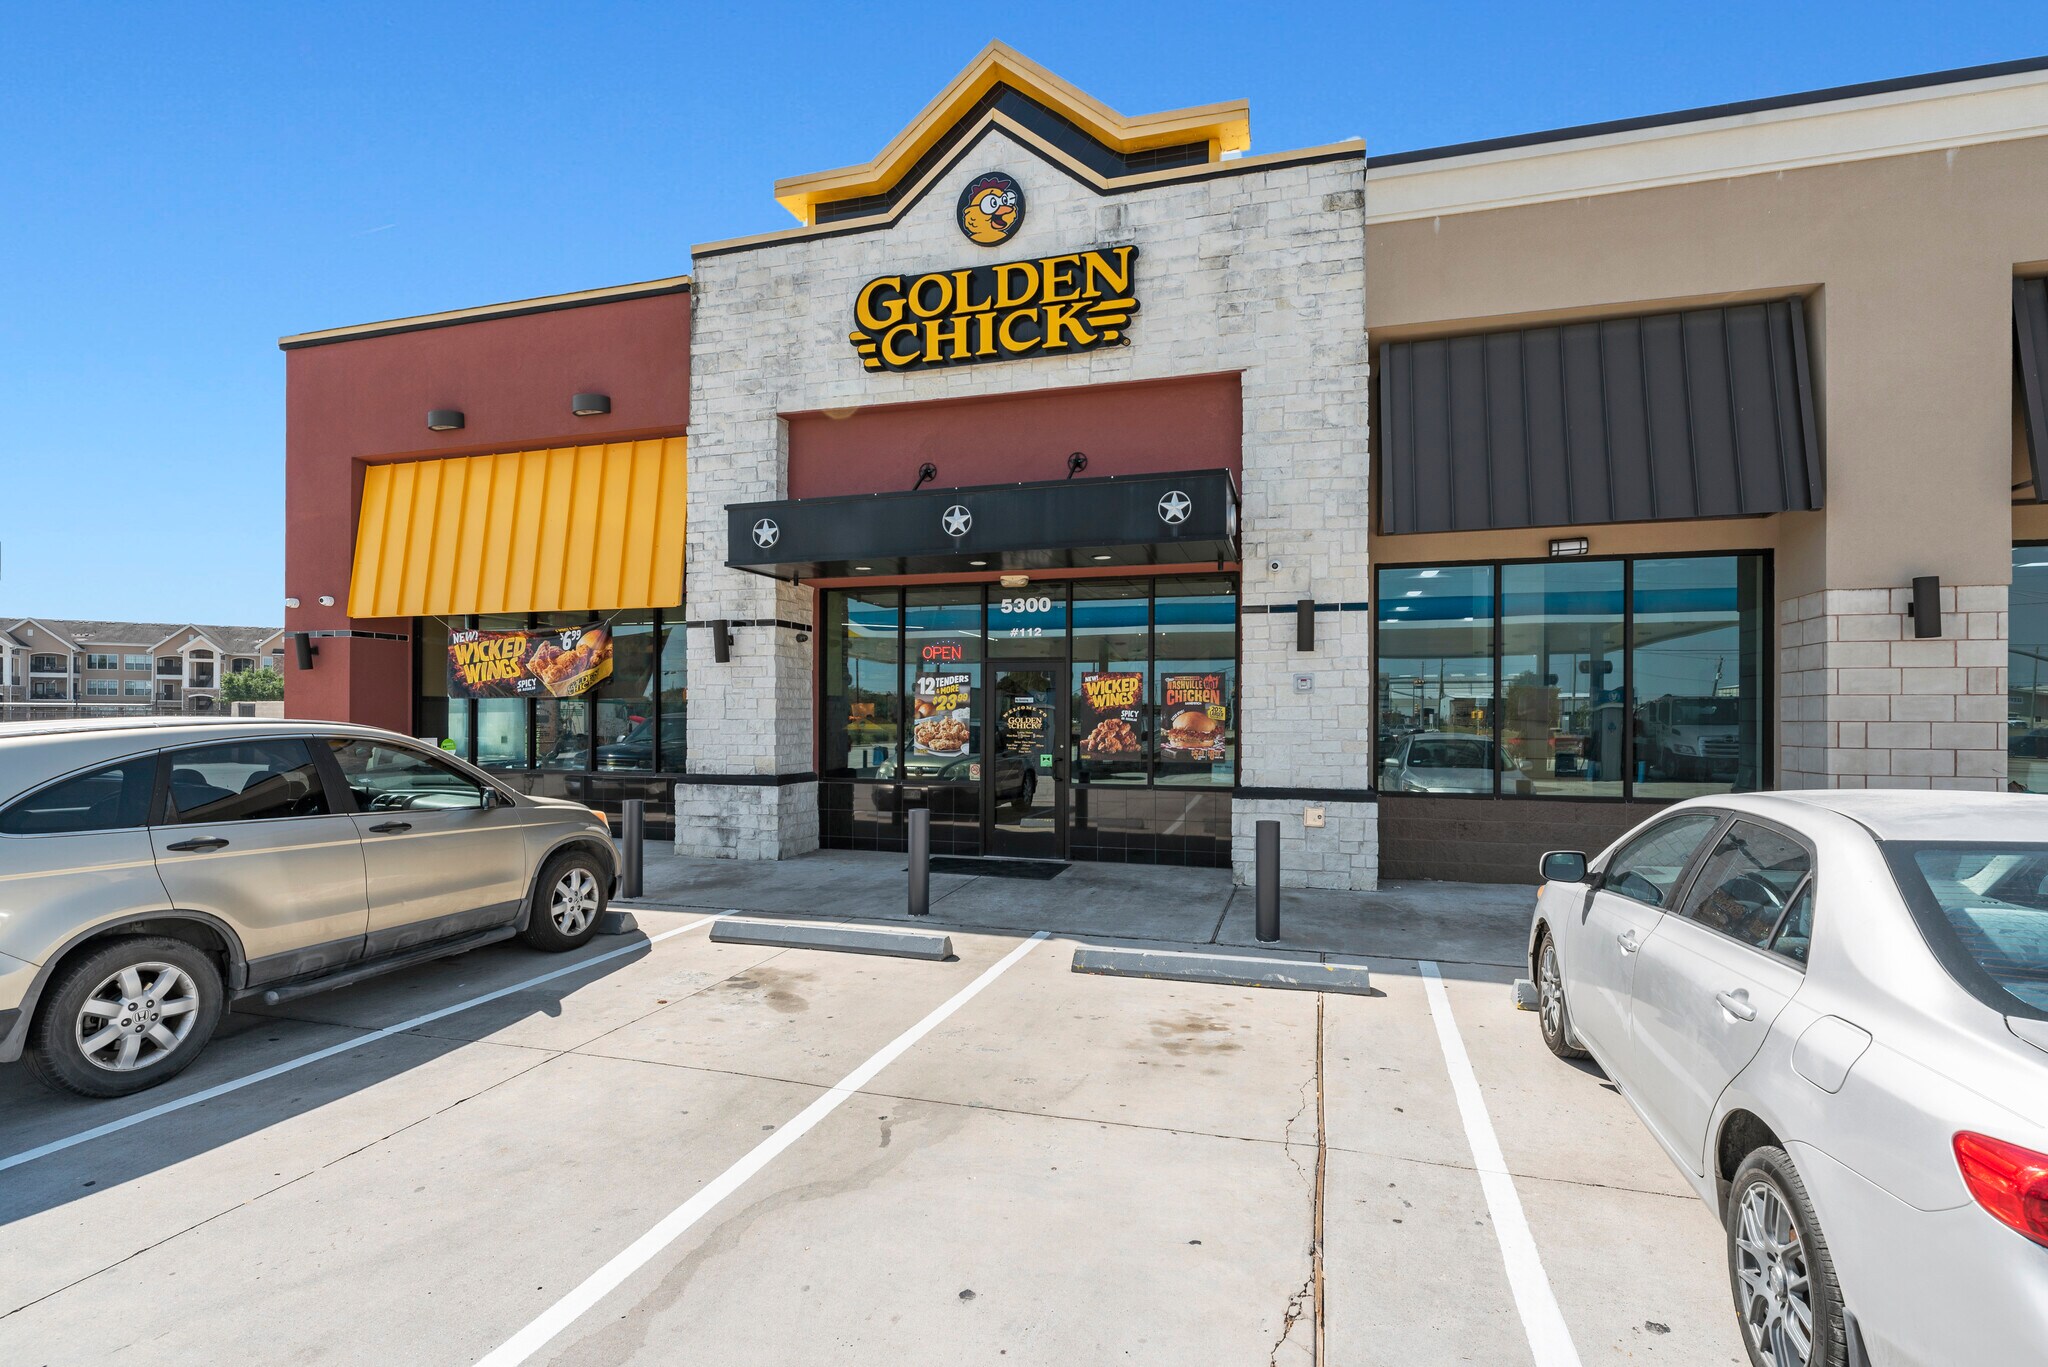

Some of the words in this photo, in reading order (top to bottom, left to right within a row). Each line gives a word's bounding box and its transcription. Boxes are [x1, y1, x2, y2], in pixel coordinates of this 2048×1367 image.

[856, 246, 1133, 330] GOLDEN
[881, 301, 1098, 366] CHICK
[1001, 597, 1051, 613] 5300
[453, 631, 479, 644] NEW!
[1010, 628, 1042, 637] #112
[454, 637, 527, 665] WICKED
[922, 646, 962, 660] OPEN
[463, 657, 521, 684] WINGS
[517, 678, 537, 689] SPICY
[917, 677, 935, 695] 12
[936, 675, 969, 687] TENDERS
[940, 684, 960, 694] MORE
[1086, 678, 1139, 695] WICKED
[1167, 680, 1203, 689] NASHVILLE
[1092, 692, 1134, 707] WINGS
[1003, 705, 1037, 718] WELCOME
[1121, 710, 1139, 718] SPICY
